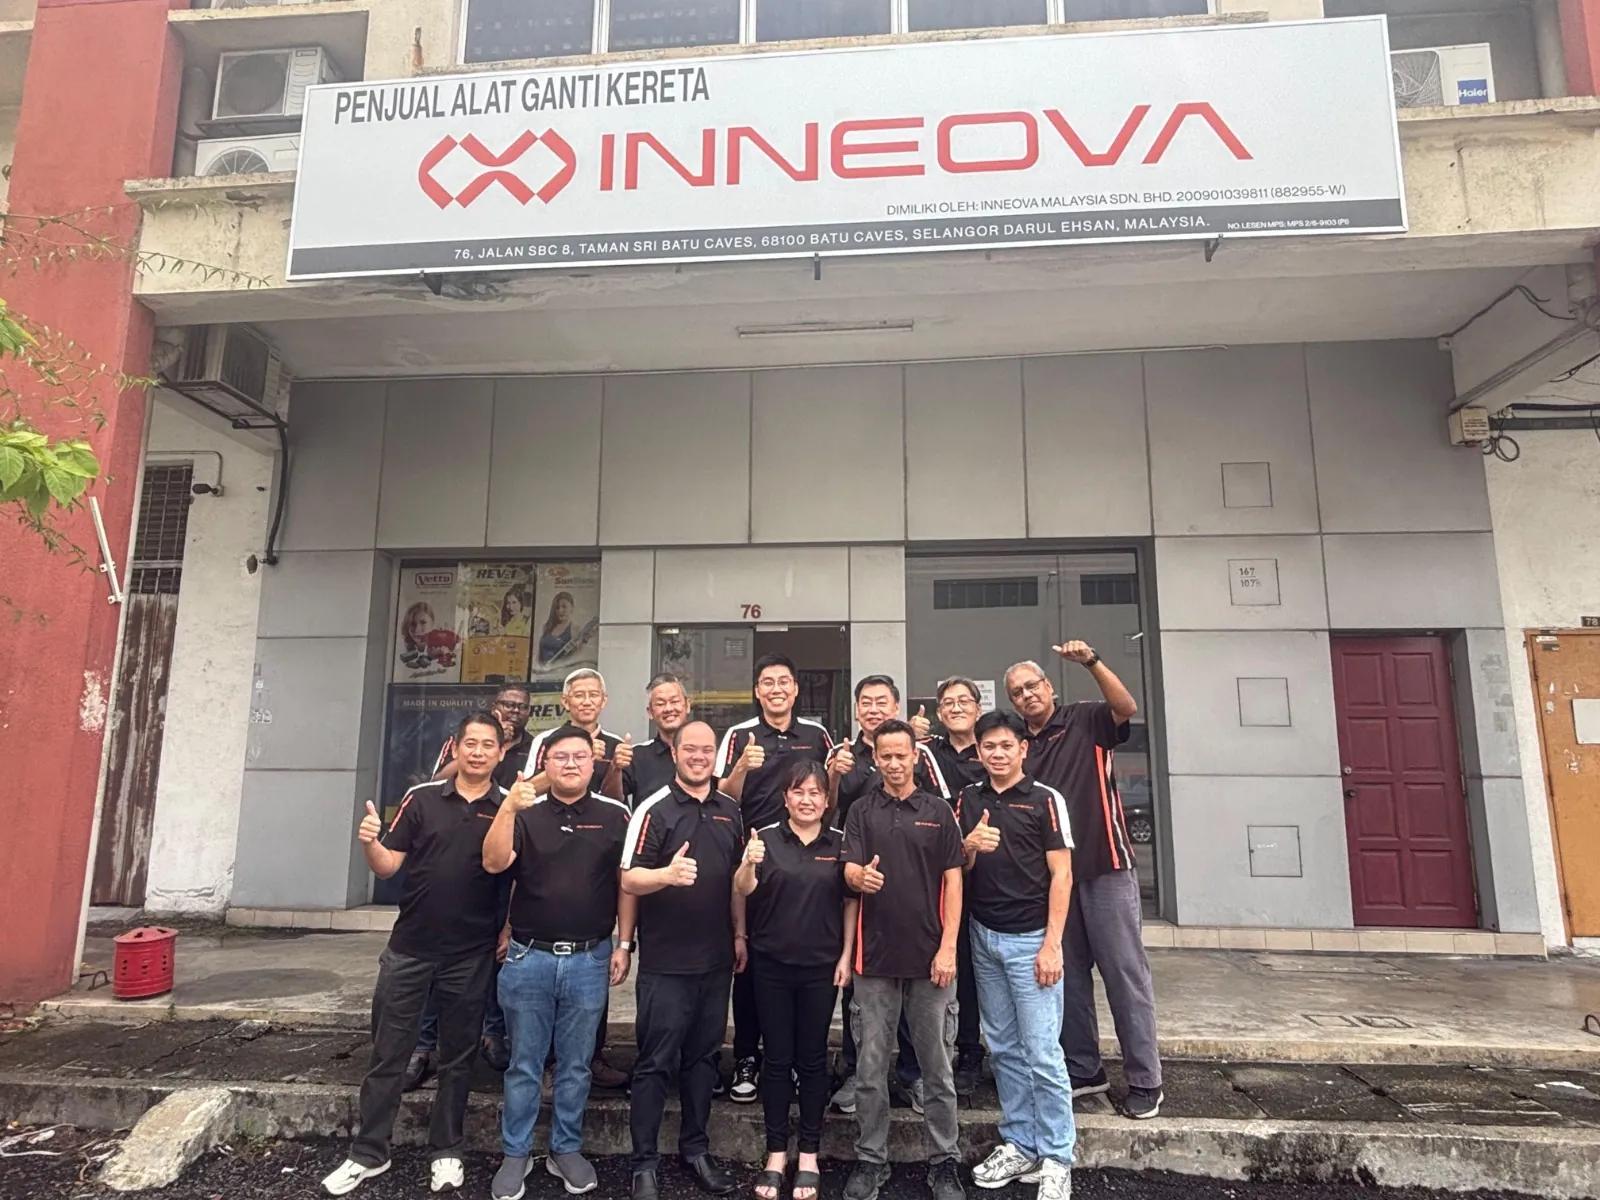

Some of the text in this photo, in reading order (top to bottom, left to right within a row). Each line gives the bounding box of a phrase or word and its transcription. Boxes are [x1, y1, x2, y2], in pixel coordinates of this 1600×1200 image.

[335, 67, 710, 124] PENJUAL ALAT GANTI KERETA
[1459, 88, 1488, 98] Haier
[599, 102, 1254, 191] INNEOVA
[887, 184, 1346, 216] DIMILIKI OLEH: INNEOVA MALAYSIA SDN. BHD. 200901039811 (882955-W)
[1241, 221, 1267, 229] LESEN
[454, 215, 1211, 260] 76, JALAN SBC 8, TAMAN SRI BATU CAVES, 68100 BATU CAVES, SELANGOR DARUL EHSAN, MALAYSIA.
[740, 604, 762, 619] 76
[1585, 617, 1599, 626] 78
[440, 699, 474, 707] QUALITY
